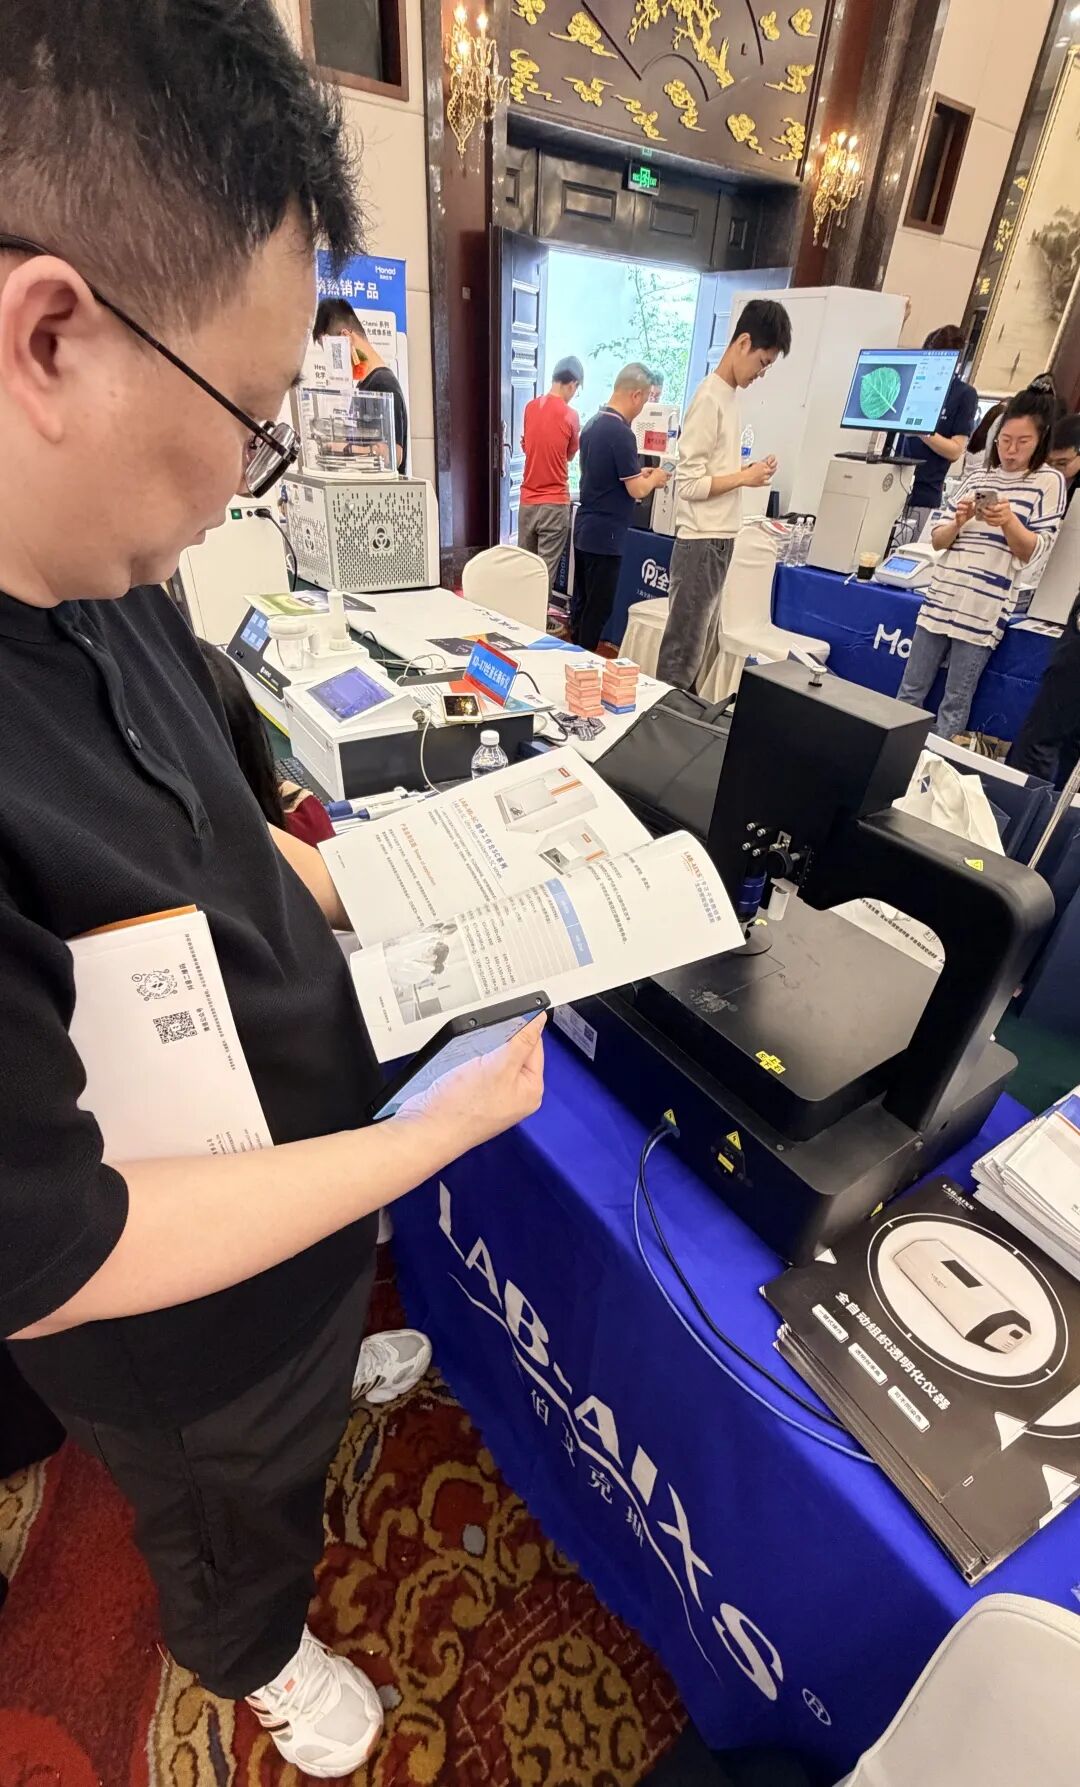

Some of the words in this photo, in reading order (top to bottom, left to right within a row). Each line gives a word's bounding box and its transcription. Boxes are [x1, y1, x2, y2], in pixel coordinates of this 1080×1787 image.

[178, 962, 194, 991] 抖音二维码
[195, 1006, 210, 1032] 微信公众号
[835, 1292, 952, 1411] 全自动组织透明化仪器
[438, 1181, 784, 1701] LAB-AIXS
